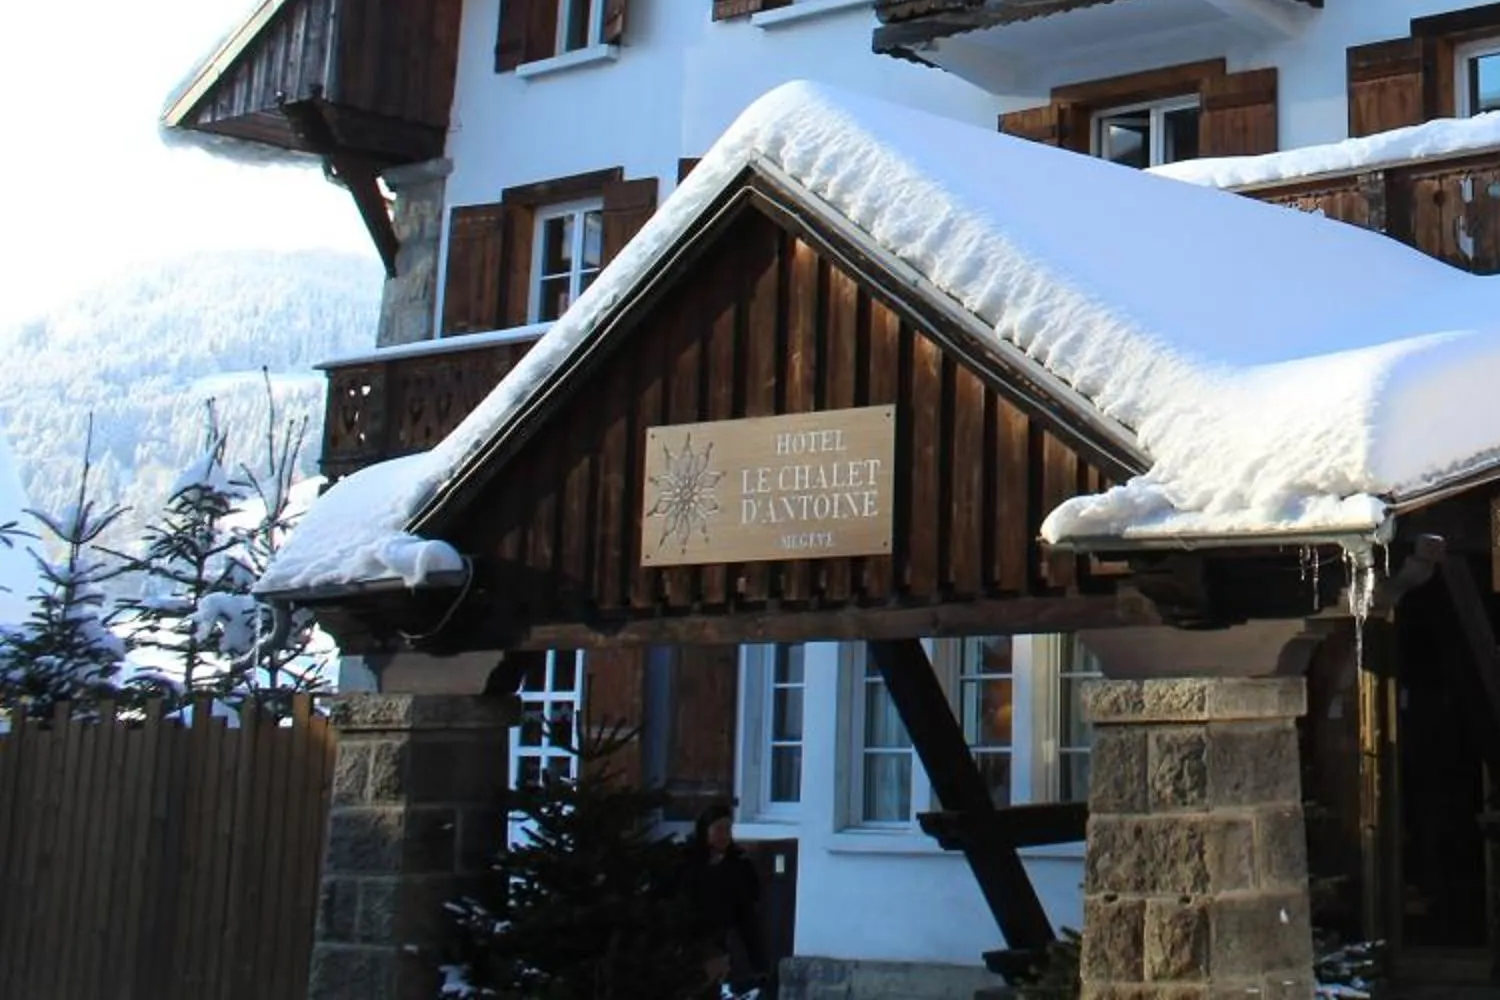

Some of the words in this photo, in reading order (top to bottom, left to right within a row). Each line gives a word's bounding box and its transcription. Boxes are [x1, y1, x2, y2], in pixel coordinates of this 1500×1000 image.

[776, 429, 846, 455] HOTEL
[741, 467, 771, 495] LE
[778, 459, 881, 491] CHALET
[741, 490, 879, 525] D'ANTOINE
